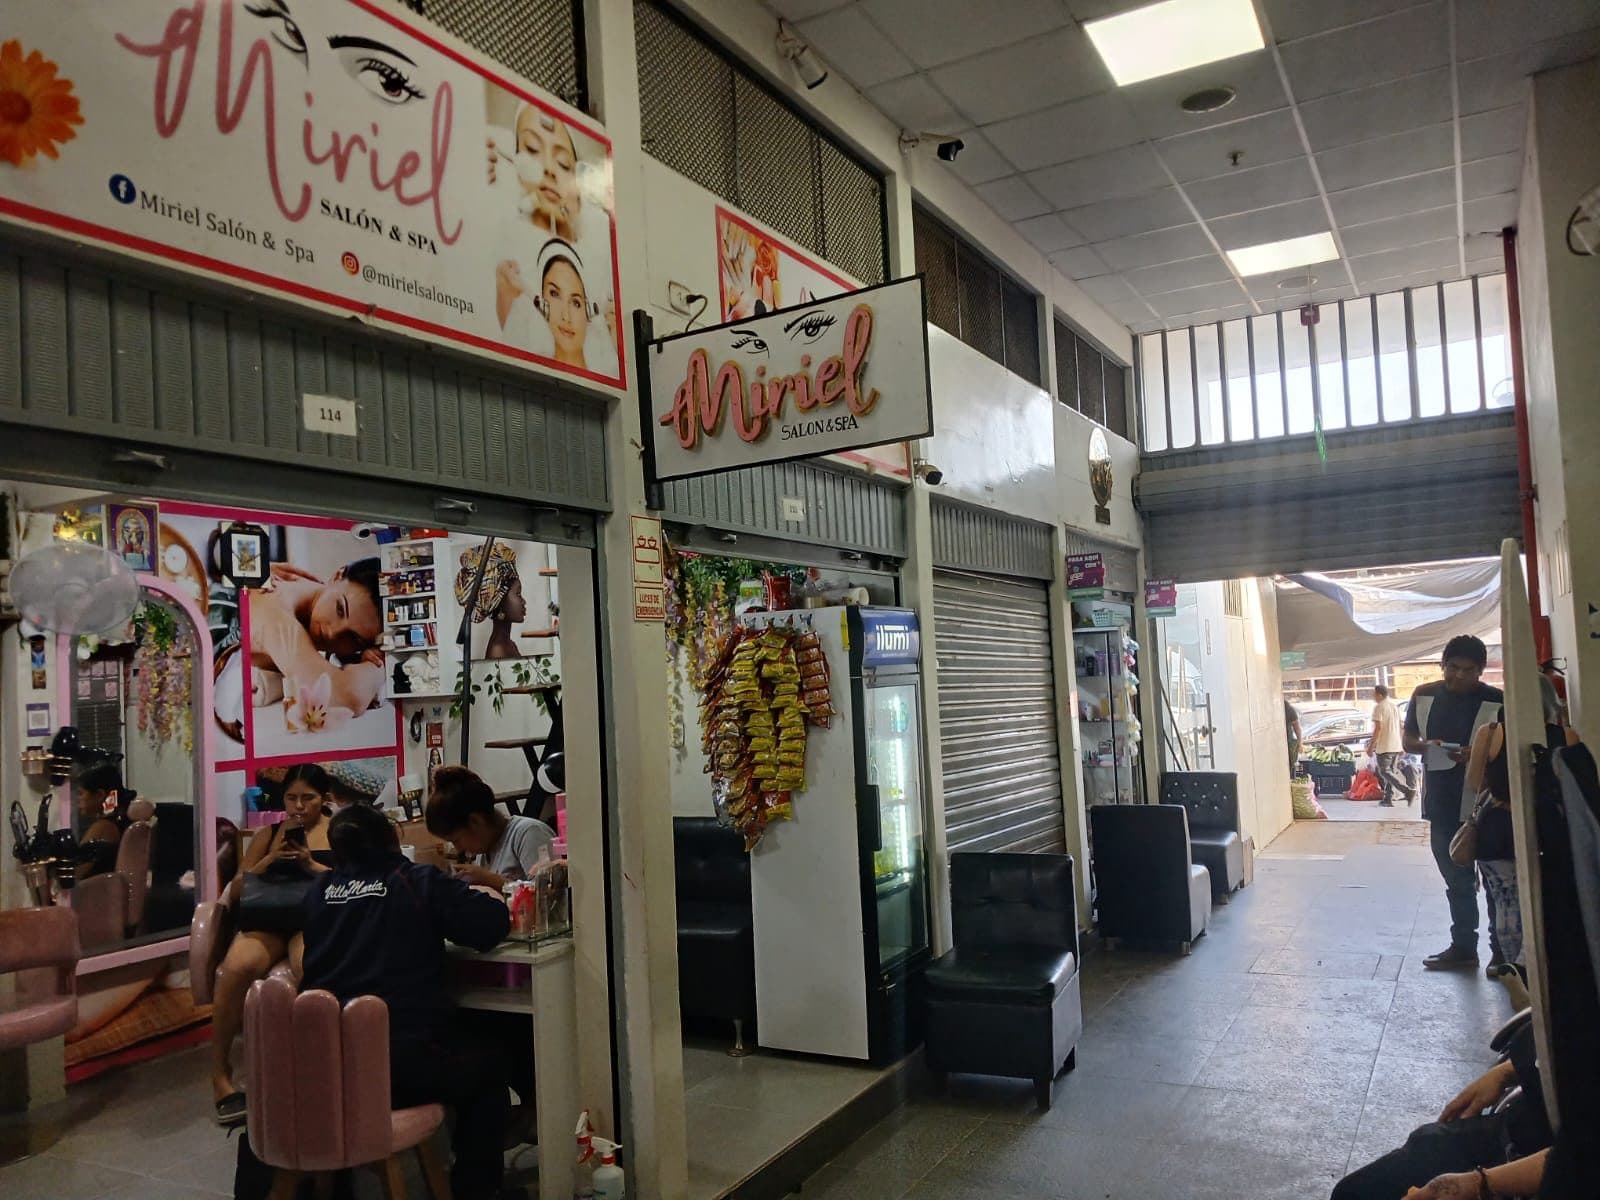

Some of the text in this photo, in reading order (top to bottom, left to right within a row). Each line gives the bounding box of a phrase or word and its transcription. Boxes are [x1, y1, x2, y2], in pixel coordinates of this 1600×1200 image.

[115, 0, 463, 246] Miriel
[140, 190, 315, 264] Miriel Salón & Spa
[320, 198, 438, 255] SALÓN & SPA
[362, 264, 475, 315] @mirielsalonspa
[660, 303, 881, 450] Miriel
[320, 407, 342, 422] 114
[875, 624, 910, 651] ilumi
